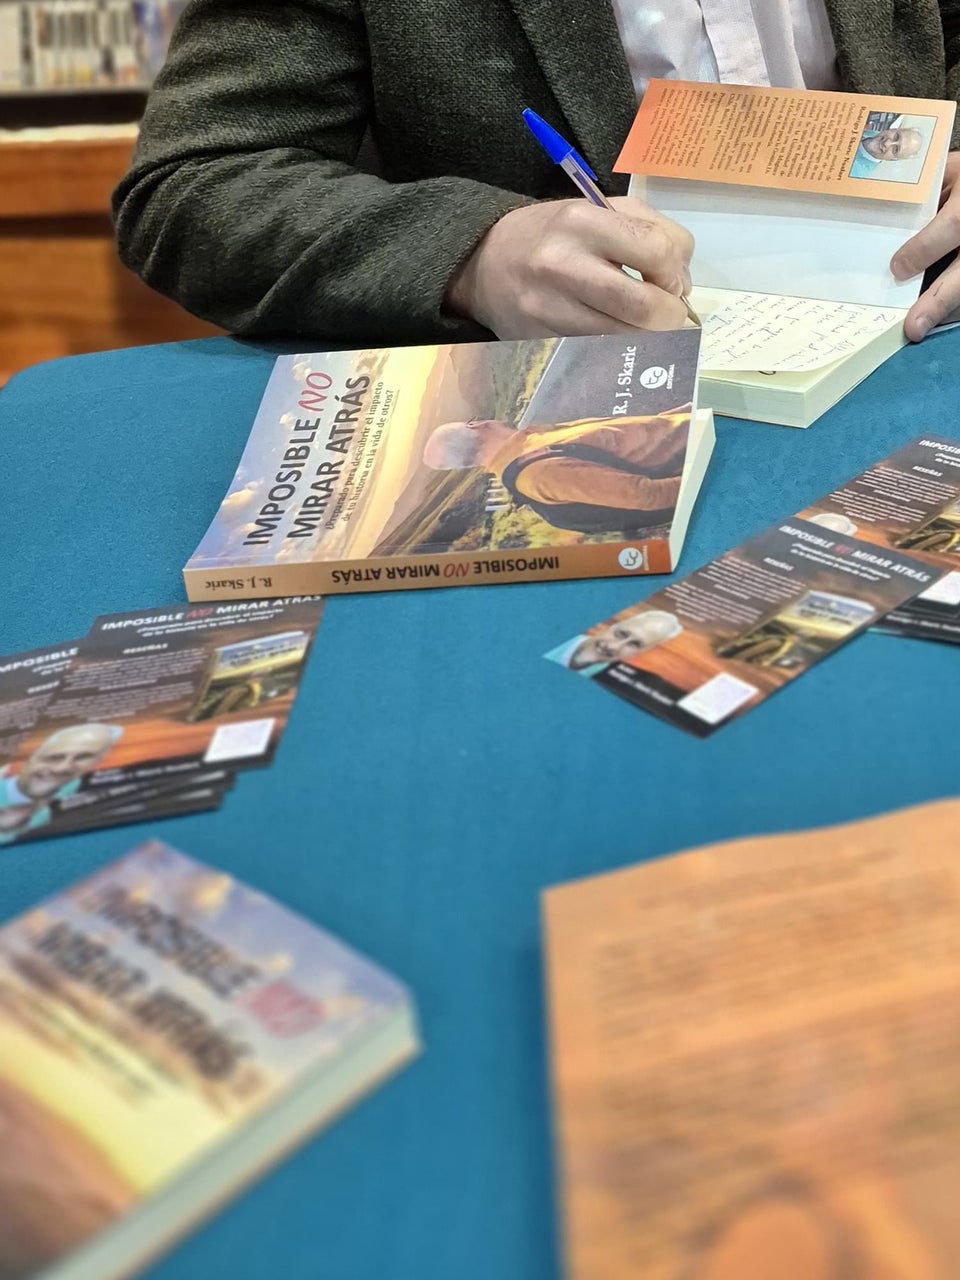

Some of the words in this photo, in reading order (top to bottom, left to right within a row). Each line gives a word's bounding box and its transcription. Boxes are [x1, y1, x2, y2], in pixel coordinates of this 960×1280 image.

[618, 345, 637, 385] Skaric
[368, 381, 384, 415] impacto
[615, 388, 632, 399] J.
[612, 400, 628, 415] R.
[243, 417, 321, 546] IMPOSIBLE
[298, 372, 333, 412] NO
[286, 460, 345, 538] MIRAR
[325, 375, 371, 454] ATRÁS
[778, 525, 836, 549] IMPOSIBLE
[851, 550, 891, 568] MIRAR
[890, 562, 932, 583] ATRÁS
[332, 565, 381, 583] ATRÁS
[386, 563, 440, 579] MIRAR
[443, 562, 470, 579] NO
[473, 556, 560, 575] IMPOSIBLE
[204, 577, 244, 590] Skaric
[102, 612, 184, 631] IMPOSIBLE
[215, 600, 269, 614] MIRAR
